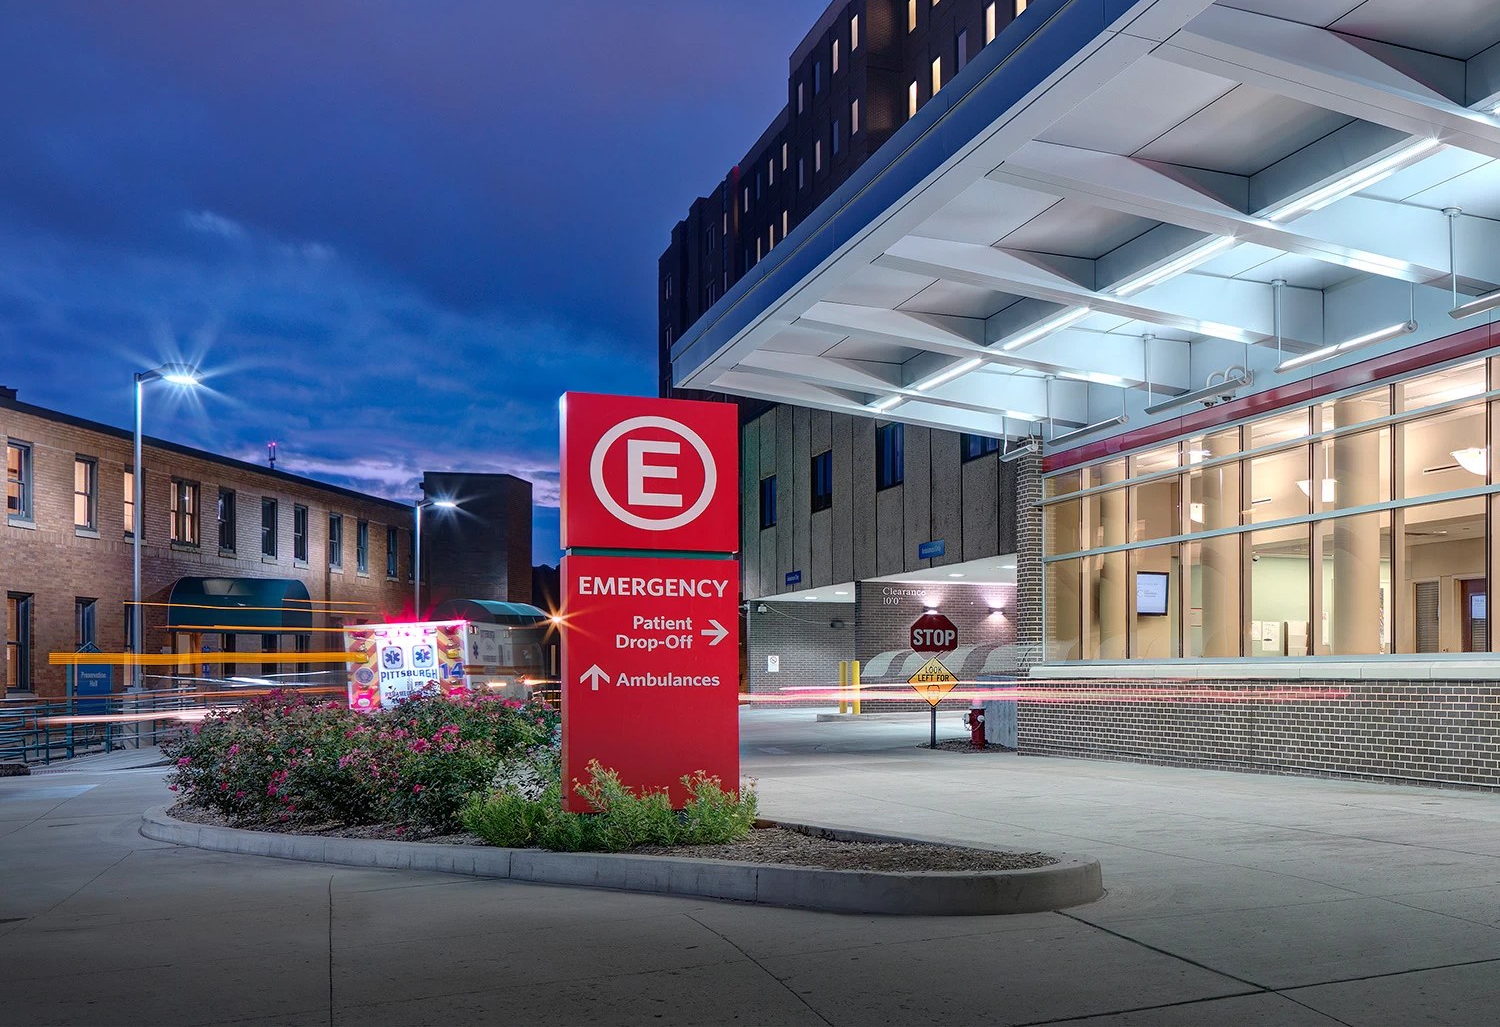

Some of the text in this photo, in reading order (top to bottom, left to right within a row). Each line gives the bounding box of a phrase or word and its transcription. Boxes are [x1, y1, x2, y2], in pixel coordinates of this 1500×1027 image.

[627, 439, 683, 508] E
[578, 576, 729, 598] EMERGENCY
[882, 586, 926, 596] Clearance
[633, 615, 693, 631] Patient
[615, 634, 693, 652] Drop-Off
[912, 629, 955, 646] STOP
[380, 668, 438, 683] PITTSBURGH
[440, 662, 465, 680] 14
[918, 674, 950, 682] LEFT FOR
[925, 666, 943, 674] LOOK
[616, 672, 720, 687] Ambulances
